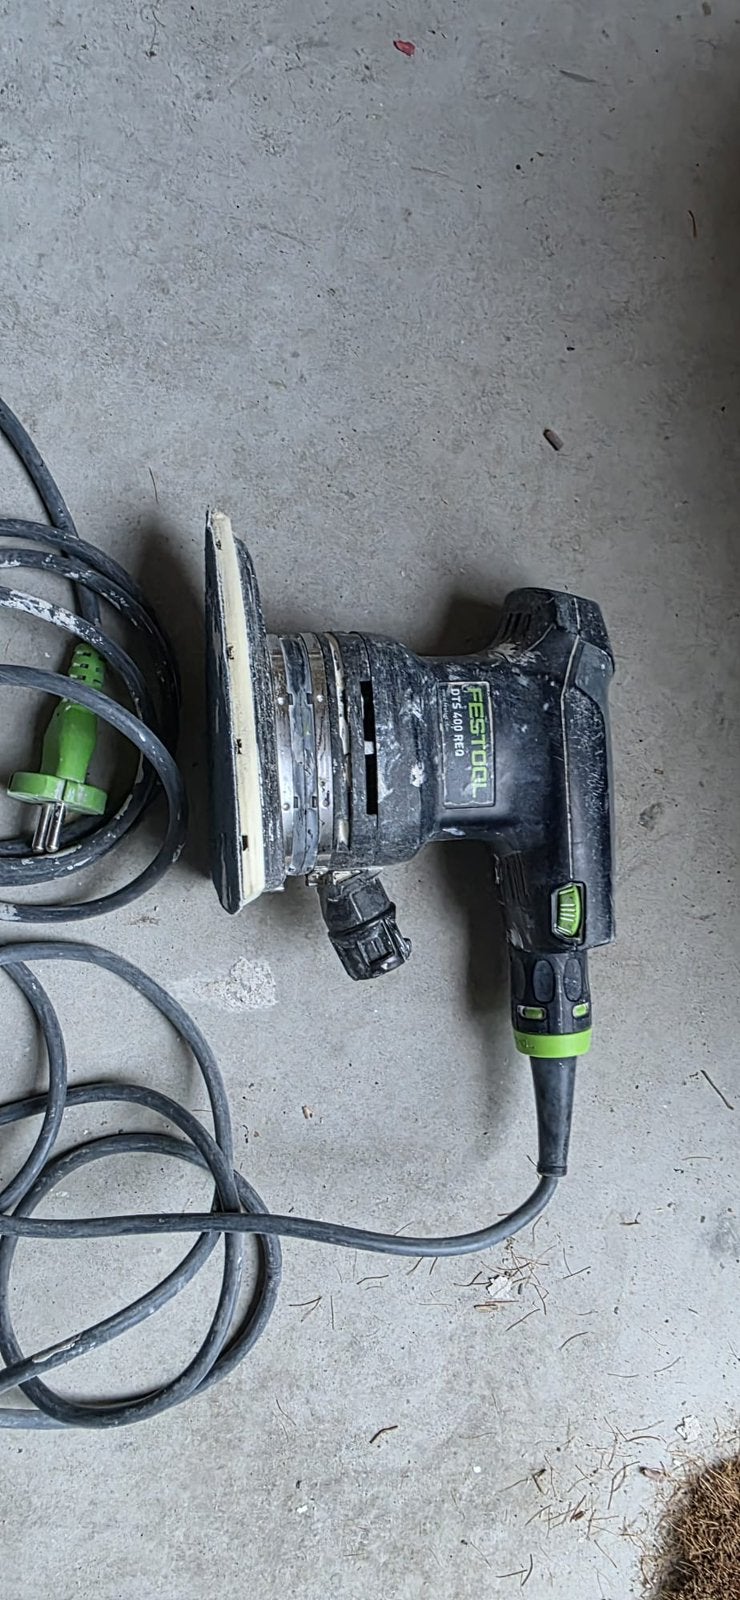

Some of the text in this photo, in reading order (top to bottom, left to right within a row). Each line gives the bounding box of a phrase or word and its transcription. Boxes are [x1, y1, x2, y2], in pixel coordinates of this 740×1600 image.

[450, 688, 464, 757] DTS 400 REQ
[468, 687, 489, 798] FESTOOL
